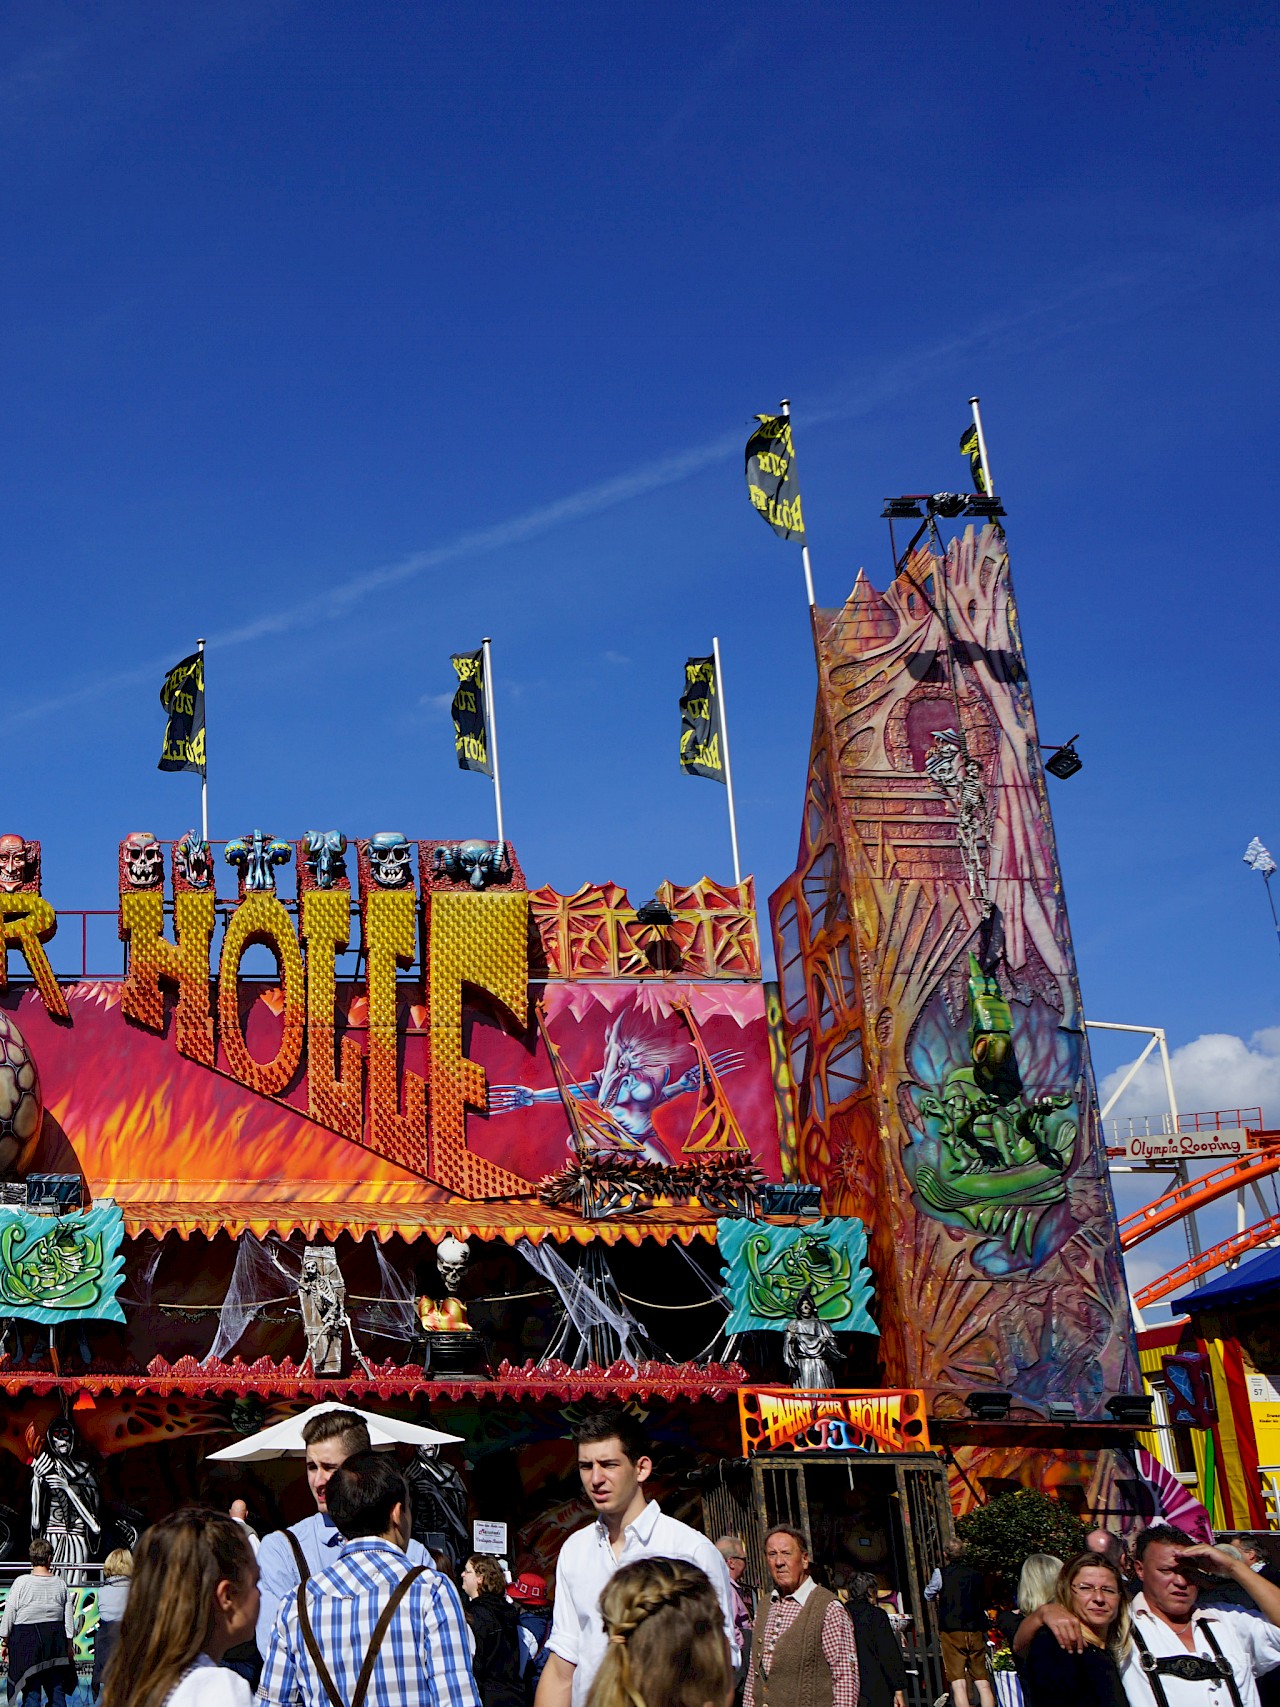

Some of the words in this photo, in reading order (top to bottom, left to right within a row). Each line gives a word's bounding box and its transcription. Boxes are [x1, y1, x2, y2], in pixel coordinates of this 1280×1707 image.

[1131, 1138, 1179, 1158] Olympia
[1180, 1135, 1241, 1155] Looping
[1254, 1388, 1263, 1396] 57
[757, 1393, 813, 1447] FAHRT
[816, 1400, 846, 1420] ZUR
[848, 1394, 903, 1449] HÖLLE
